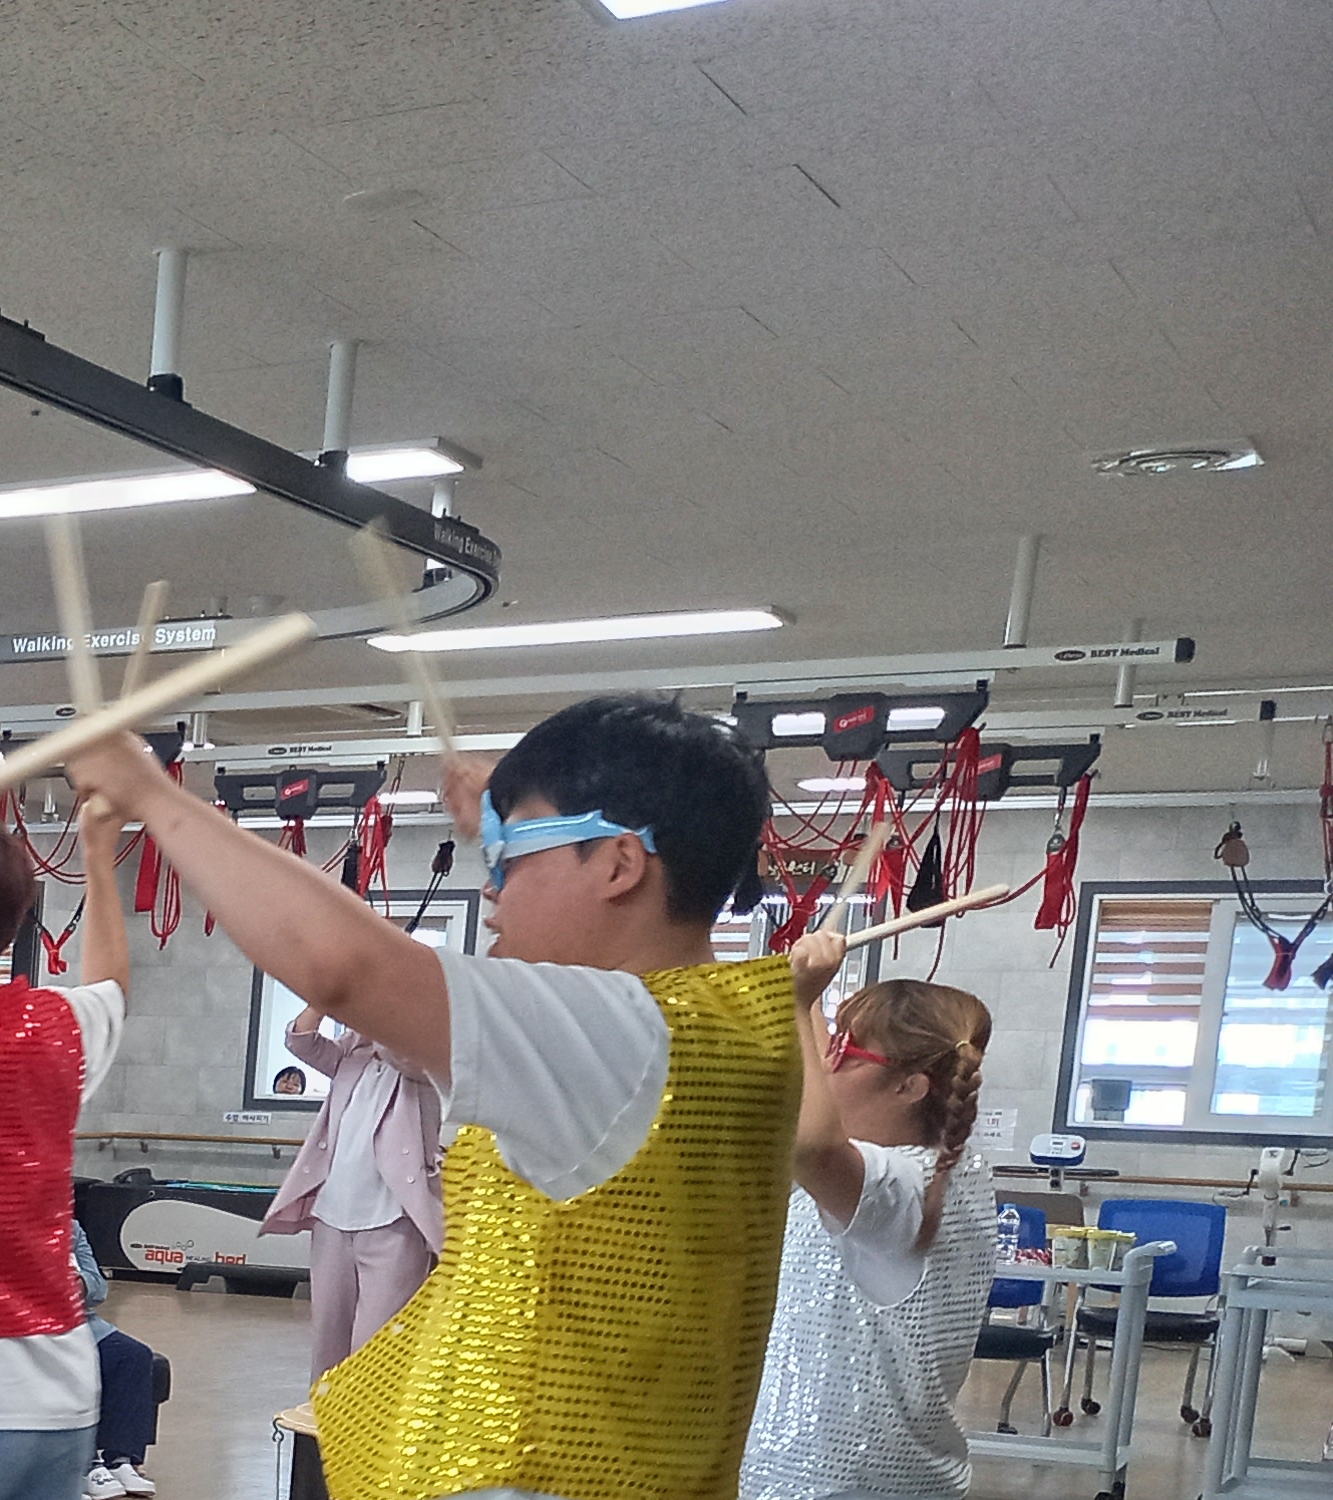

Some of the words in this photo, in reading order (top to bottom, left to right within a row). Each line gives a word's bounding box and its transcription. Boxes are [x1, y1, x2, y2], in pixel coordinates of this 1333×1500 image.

[154, 626, 216, 644] System
[1090, 649, 1119, 658] BEST
[1120, 647, 1160, 657] Medical
[1167, 710, 1191, 718] BEST
[1193, 708, 1228, 717] Medical
[144, 1249, 184, 1264] aqua
